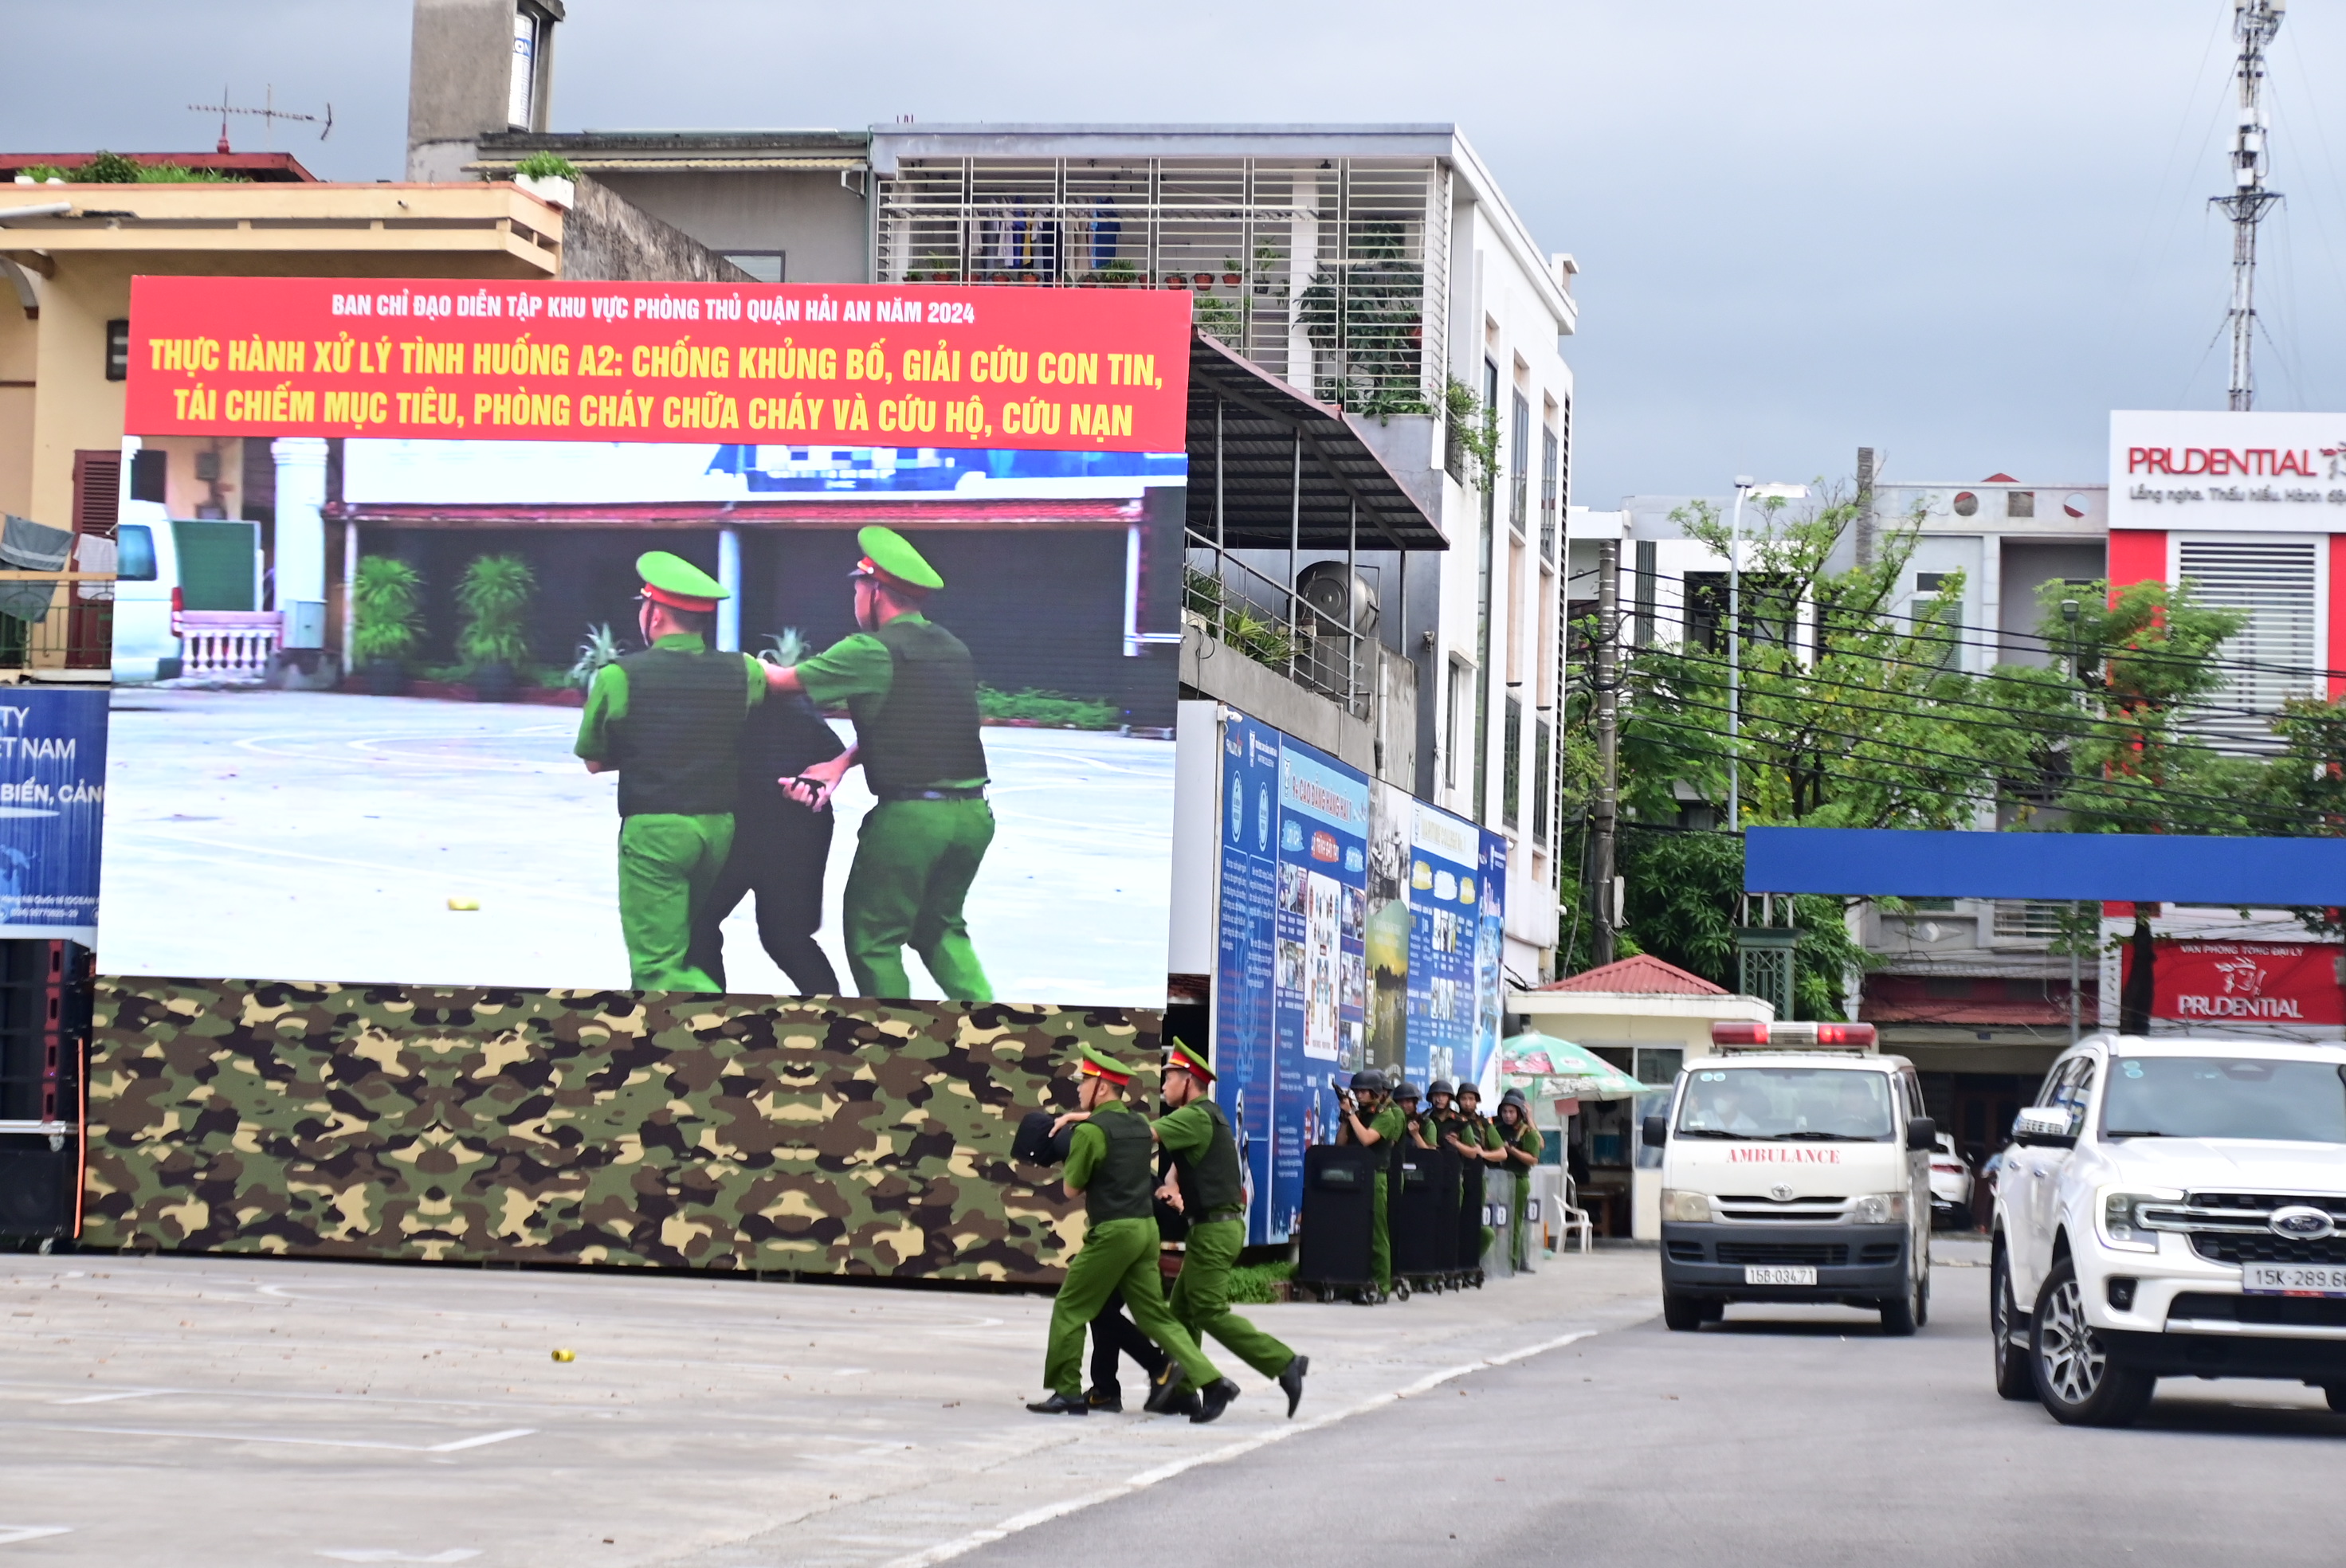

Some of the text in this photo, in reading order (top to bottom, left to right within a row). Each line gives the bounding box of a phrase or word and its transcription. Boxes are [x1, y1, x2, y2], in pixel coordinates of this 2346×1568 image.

[332, 288, 975, 326] BAN CHỈ ĐẠO DIỄN TẬP KHU VỰC PHÒNG THỦ QUẬN HẢI AN NĂM 2024
[149, 331, 1163, 390] THỰC HÀNH XỬ LÝ TÌNH HUỐNG A2: CHỐNG KHỦNG BỐ, GIẢI CỨU CON TIN,
[174, 380, 1133, 443] TÁI CHIẾM MỤC TIÊU, PHÒNG CHÁY CHỮA CHÁY VÀ CỨU HỘ, CỨU NẠN
[2128, 446, 2318, 476] PRUDENTIAL
[22, 737, 76, 759] NAM
[57, 778, 104, 802] CẢN
[2178, 995, 2304, 1018] PRUDENTIAL
[1727, 1148, 1840, 1164] AMBULANCE
